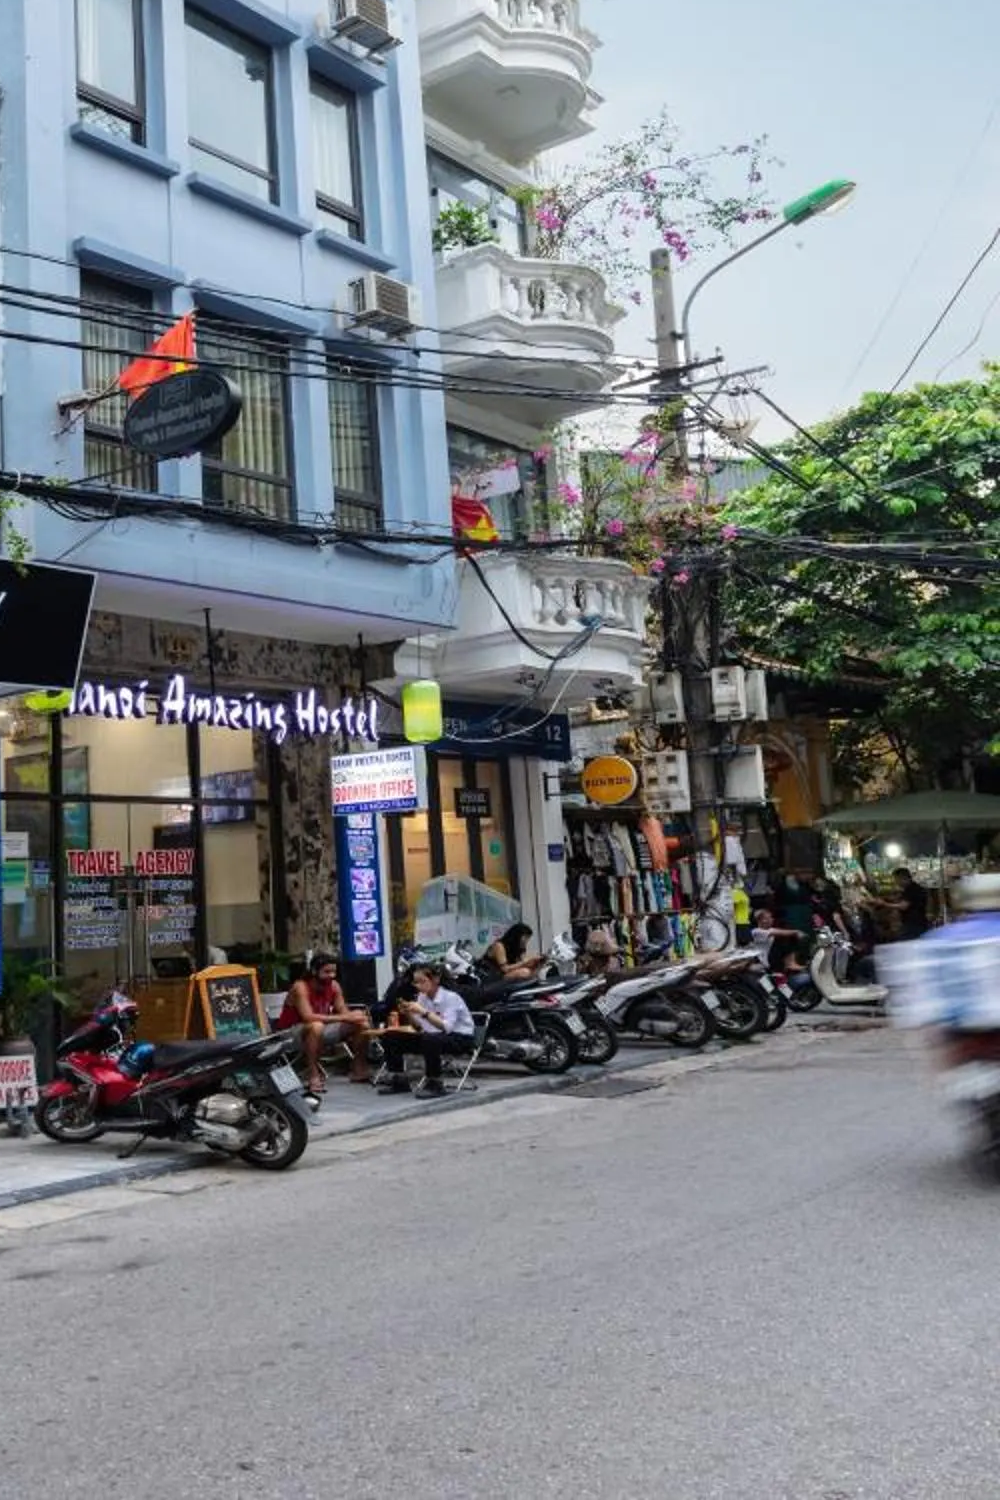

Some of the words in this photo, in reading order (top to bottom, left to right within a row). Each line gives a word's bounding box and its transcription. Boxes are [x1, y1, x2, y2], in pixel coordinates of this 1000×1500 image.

[69, 680, 149, 716] anoi
[162, 673, 287, 744] Amazing
[295, 687, 380, 742] Hostel
[545, 725, 562, 740] 12
[67, 850, 125, 876] TRAVEL
[135, 850, 195, 876] AGENCY
